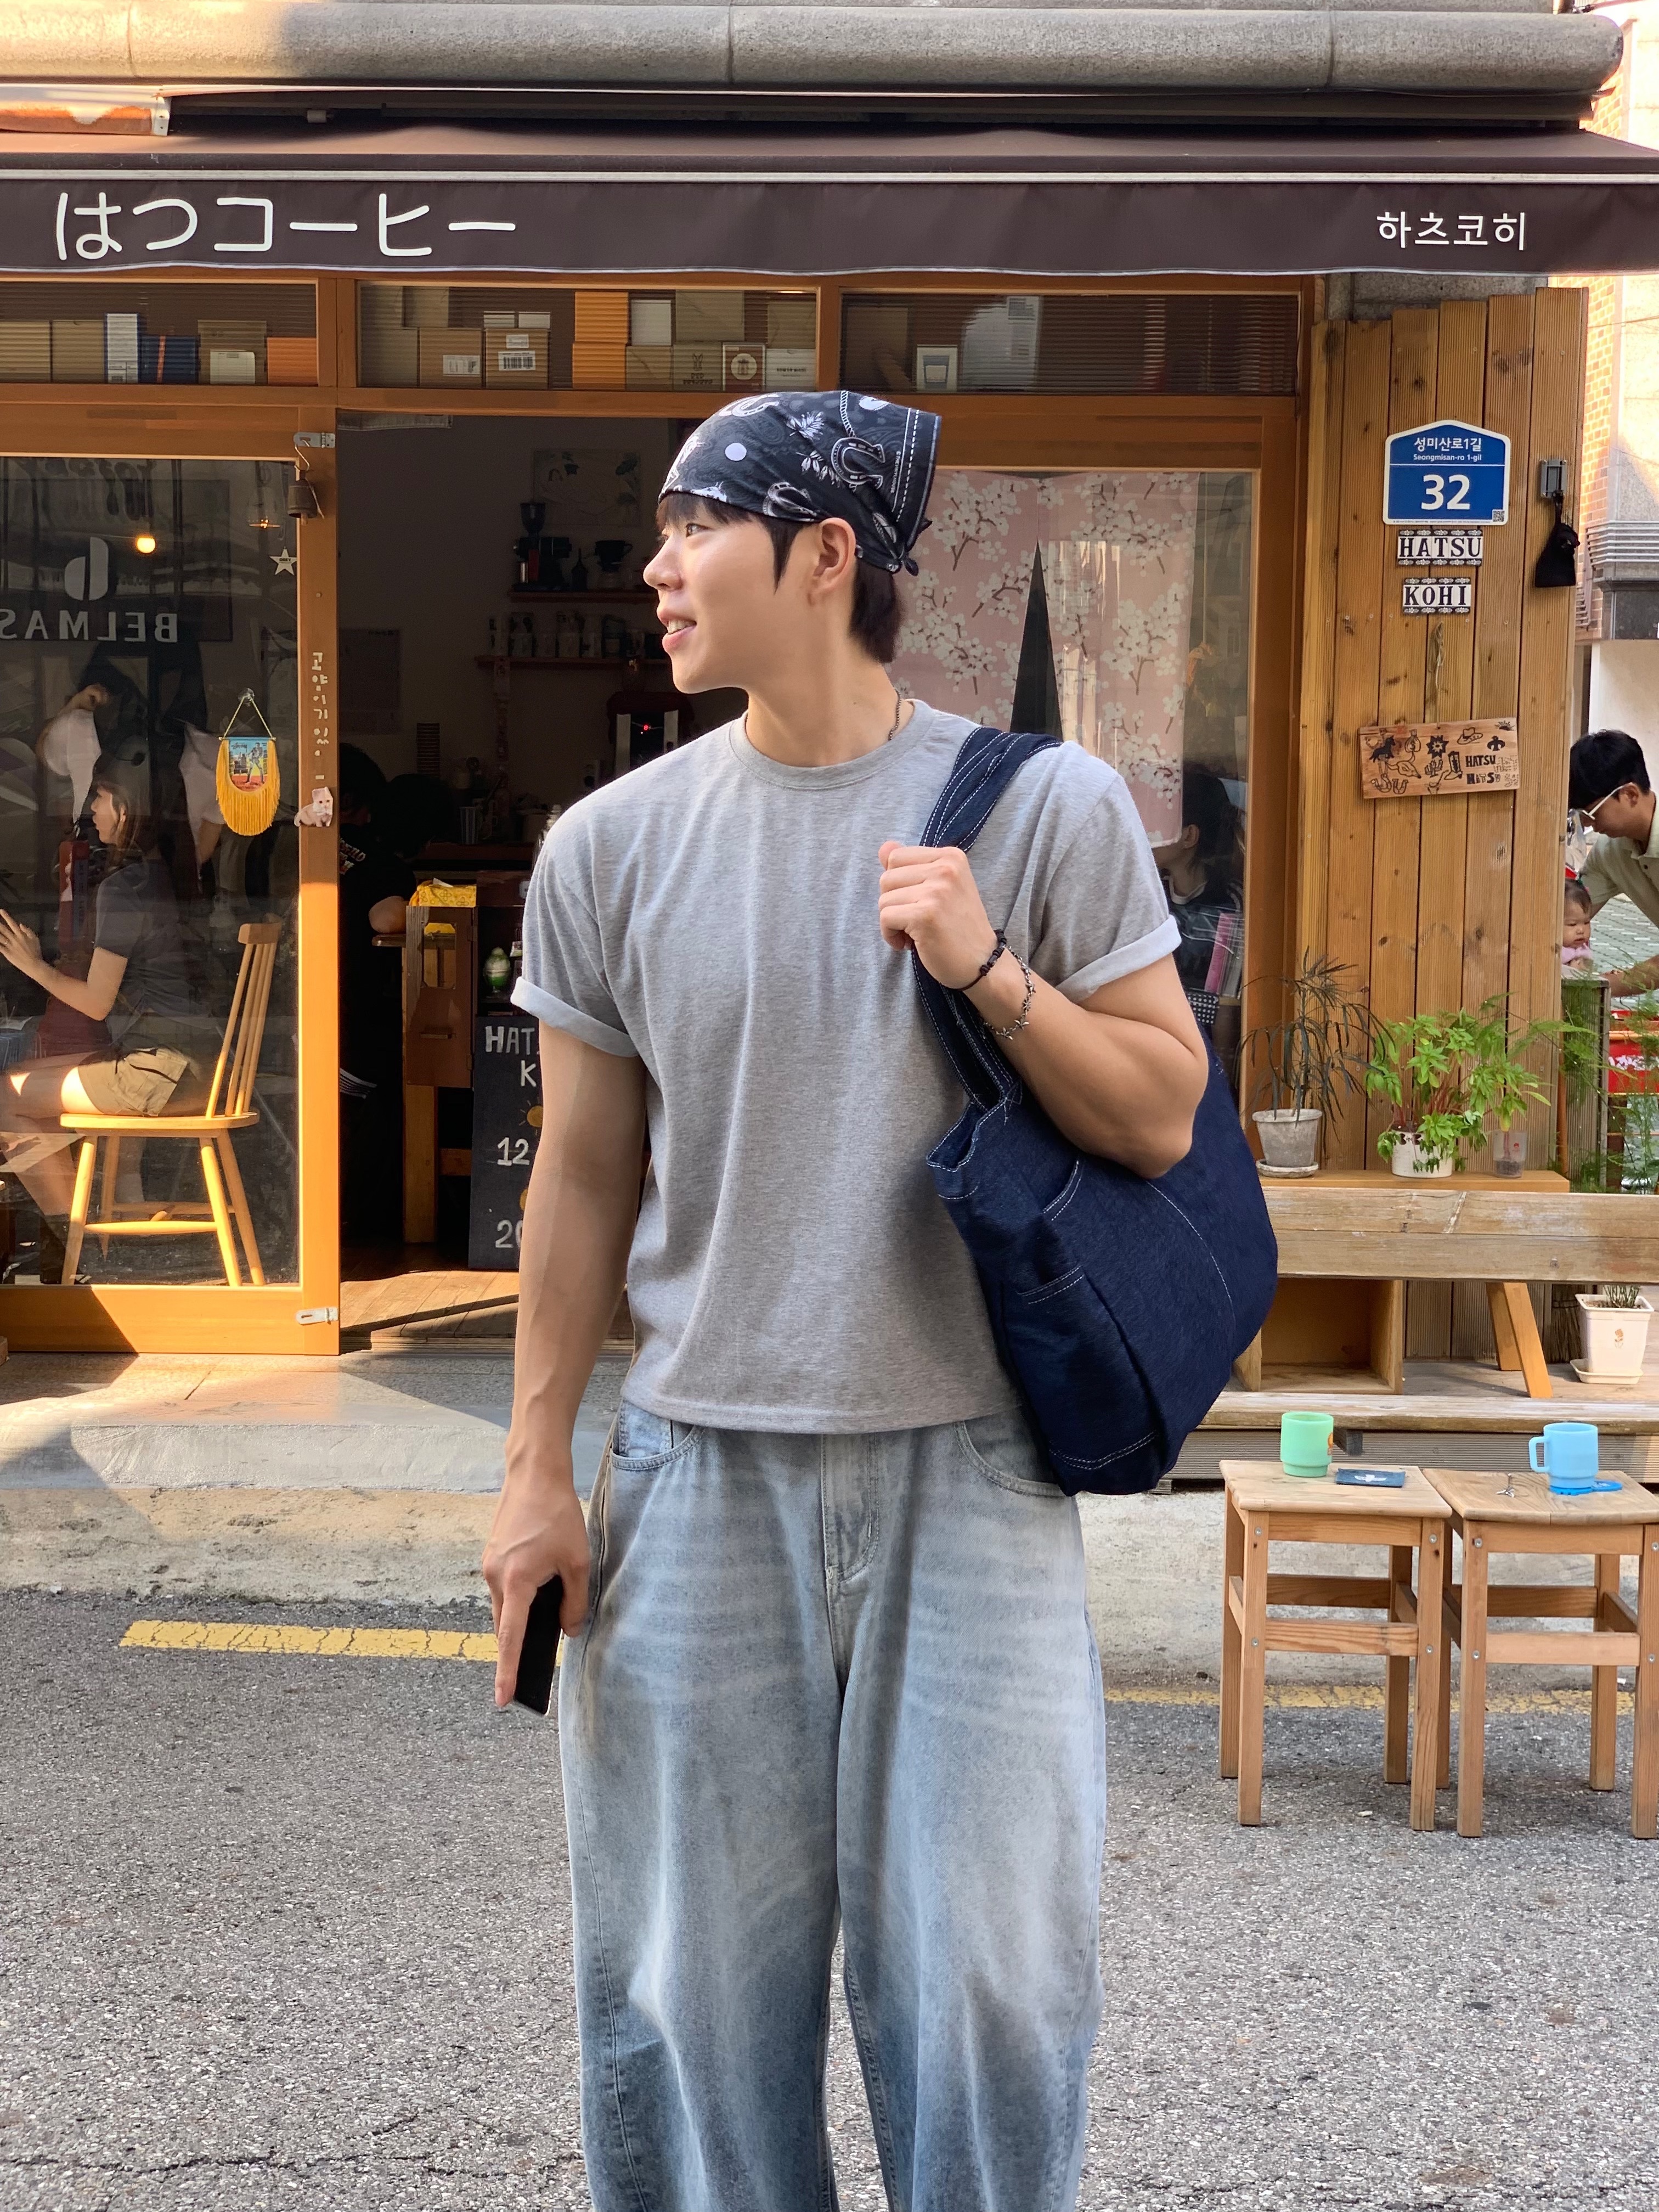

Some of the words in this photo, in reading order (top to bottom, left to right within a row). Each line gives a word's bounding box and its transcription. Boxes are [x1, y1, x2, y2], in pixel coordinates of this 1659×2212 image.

[56, 192, 516, 261] はつコーヒー
[1376, 211, 1526, 251] 하츠코히
[1414, 437, 1482, 452] 성미산로1길
[1413, 453, 1465, 461] Seongmisan-ro
[1467, 453, 1482, 462] 1-gil
[1421, 474, 1471, 510] 32
[1398, 538, 1482, 558] HATSU
[1404, 586, 1467, 606] KOHI
[1465, 755, 1496, 767] HATSU
[485, 1026, 539, 1055] HAT
[496, 1137, 530, 1166] 12
